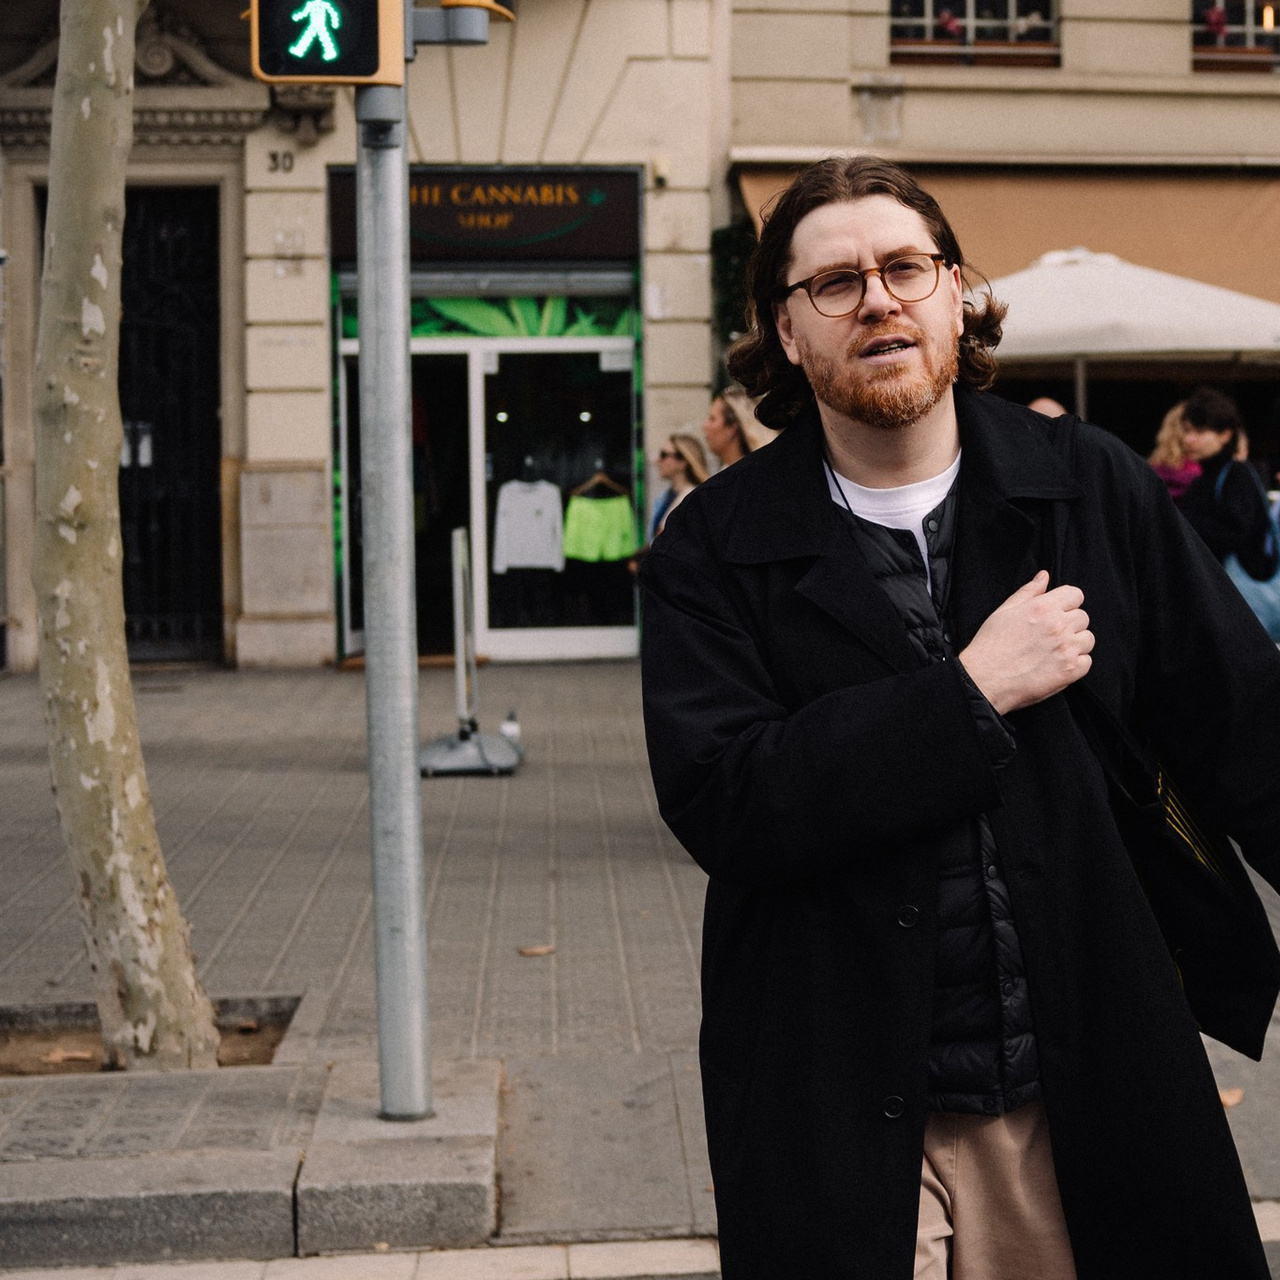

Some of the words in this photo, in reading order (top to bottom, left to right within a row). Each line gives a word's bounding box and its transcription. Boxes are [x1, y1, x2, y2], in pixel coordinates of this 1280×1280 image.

[267, 150, 295, 173] 30
[410, 184, 441, 206] HE
[450, 183, 580, 206] CANNABIS
[457, 211, 514, 230] SHOP
